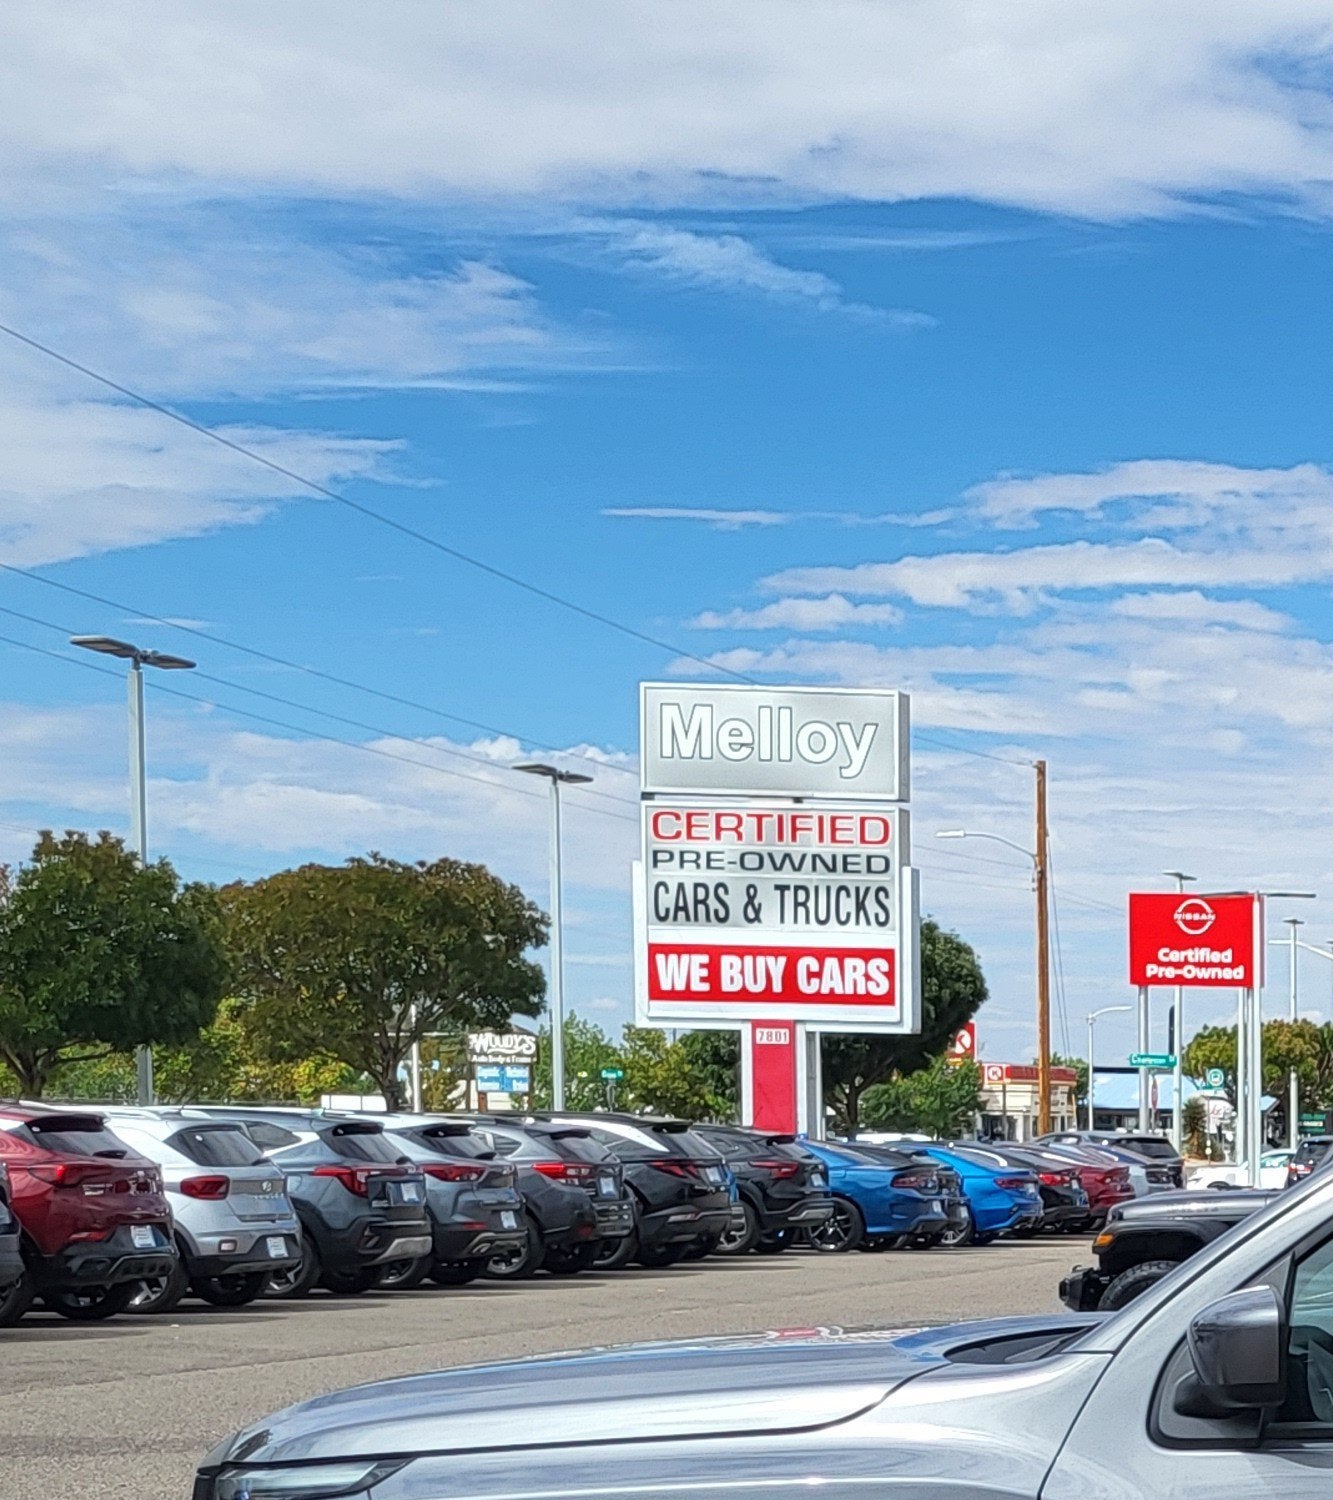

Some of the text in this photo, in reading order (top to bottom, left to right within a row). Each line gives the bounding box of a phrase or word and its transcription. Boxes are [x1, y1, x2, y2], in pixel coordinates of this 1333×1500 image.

[659, 702, 879, 779] Melloy
[652, 811, 890, 845] CERTIFIED
[652, 850, 891, 875] PRE-OWNED
[653, 881, 891, 928] CARS & TRUCKS
[1157, 947, 1233, 963] Certified
[655, 953, 890, 996] WE BUY CARS
[1145, 963, 1244, 980] Pre-Owned
[759, 1031, 788, 1043] 7801
